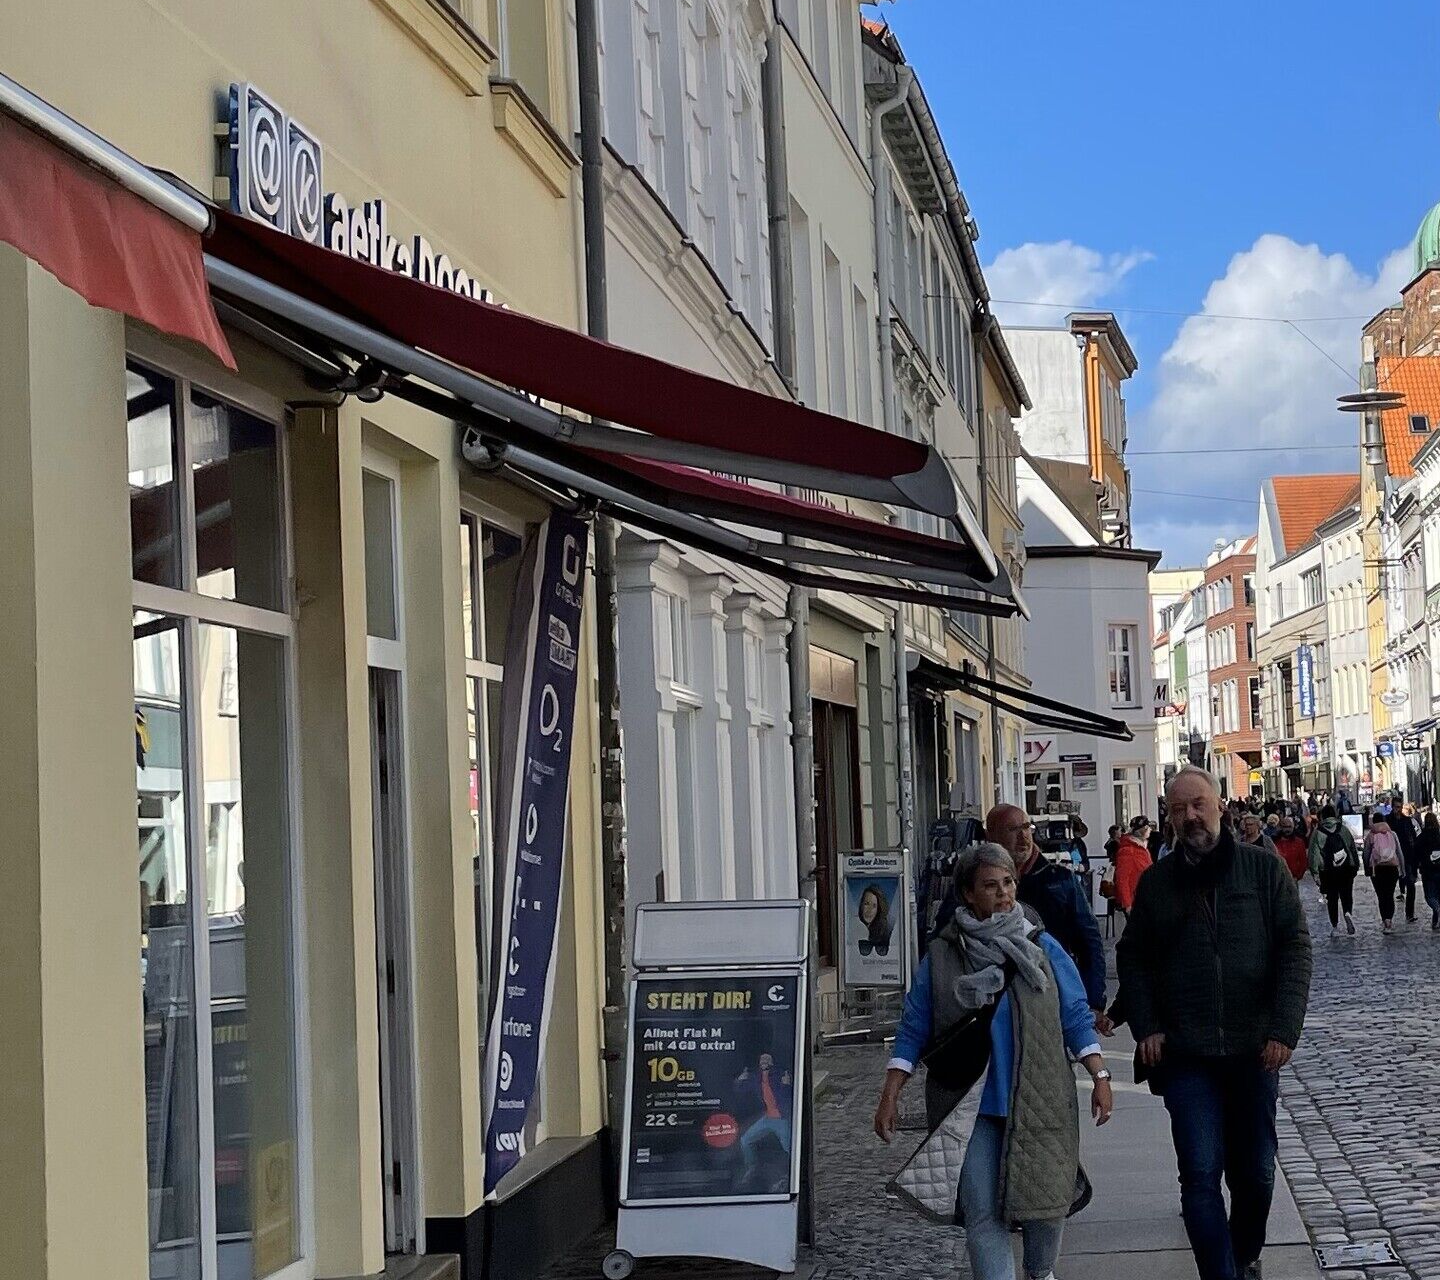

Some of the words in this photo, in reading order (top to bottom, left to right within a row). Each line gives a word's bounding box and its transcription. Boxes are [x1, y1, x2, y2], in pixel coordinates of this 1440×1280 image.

[647, 992, 708, 1010] STEHT
[712, 990, 751, 1009] DIR!
[643, 1028, 680, 1038] Allnet
[683, 1028, 707, 1038] Flat
[711, 1028, 722, 1038] M
[643, 1041, 663, 1051] mit
[700, 1040, 735, 1051] extra!
